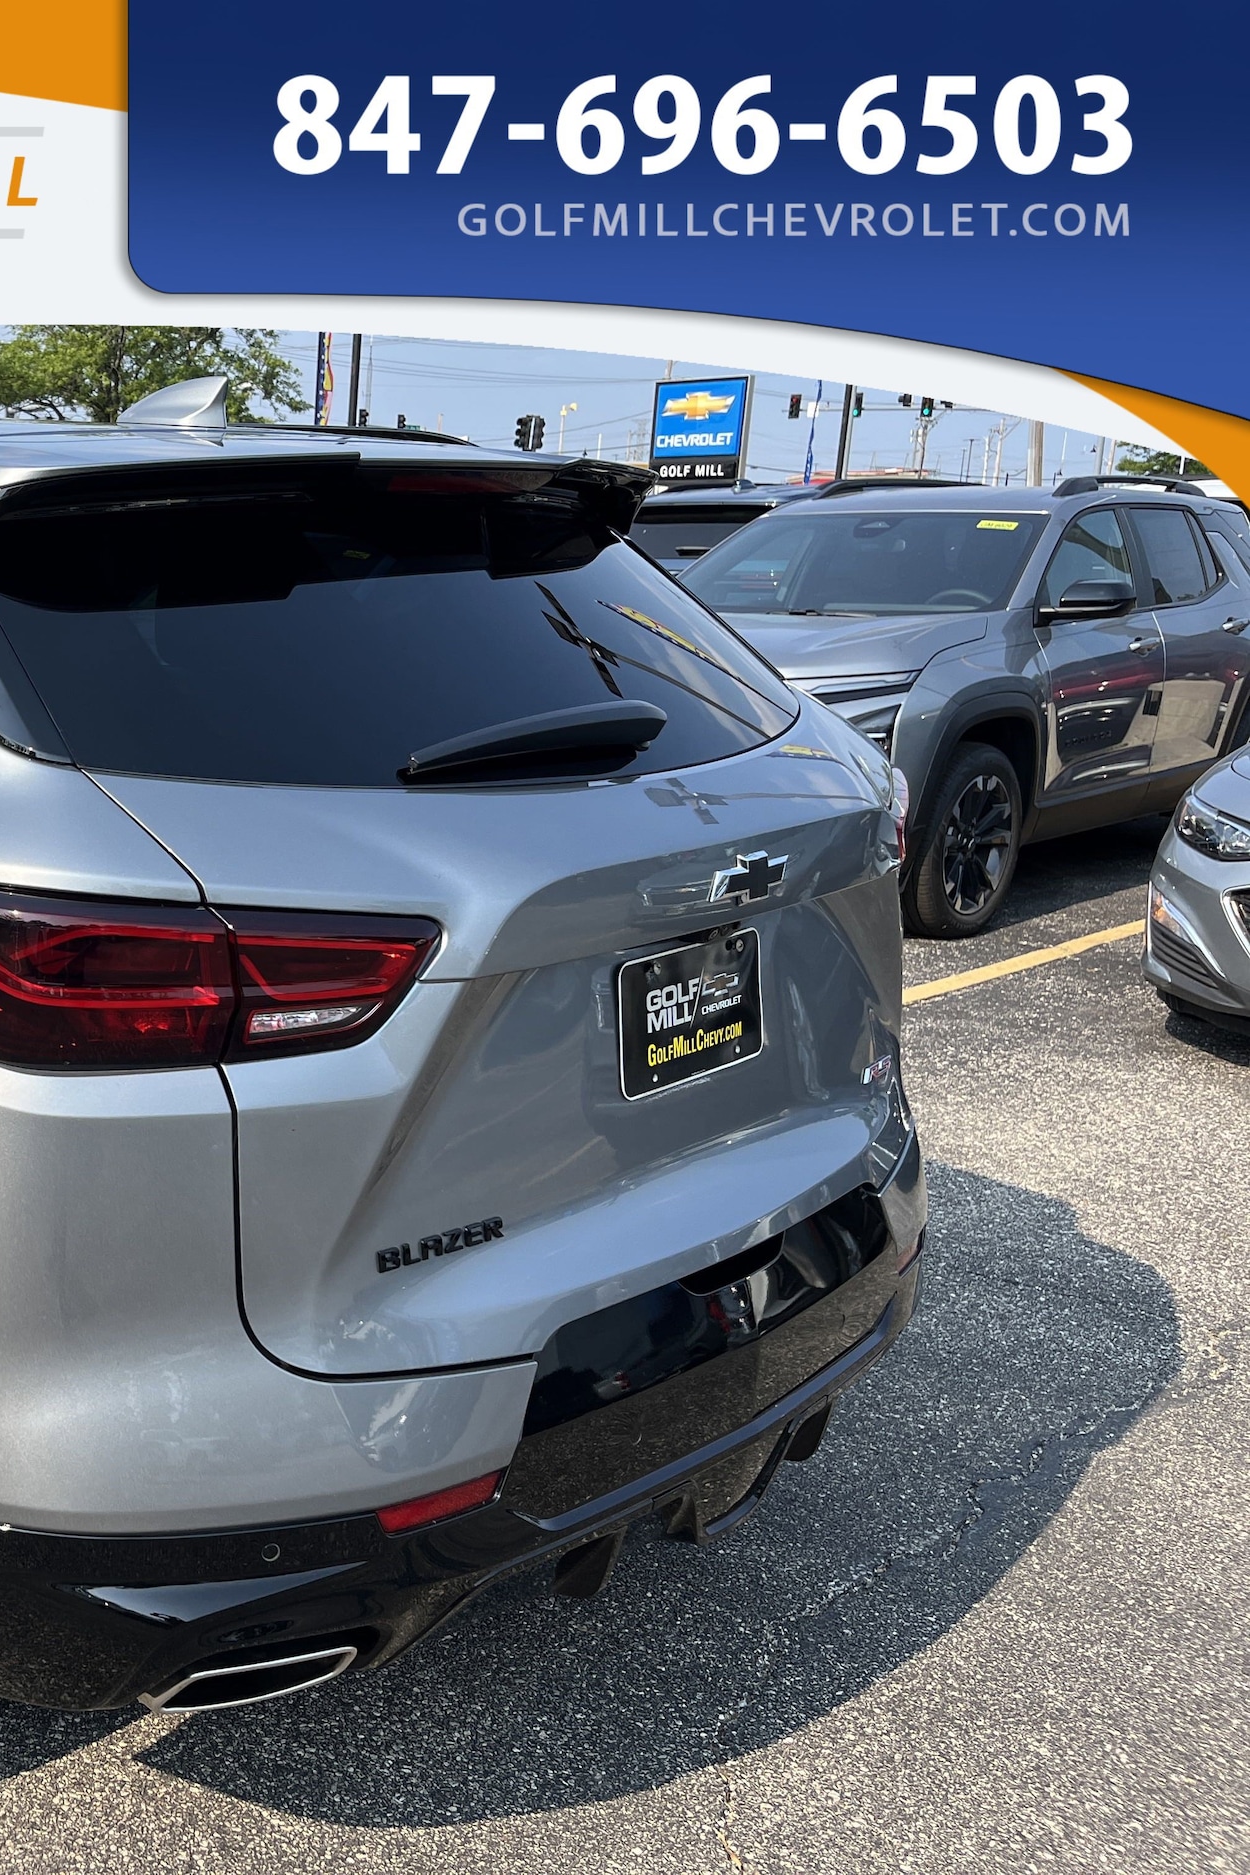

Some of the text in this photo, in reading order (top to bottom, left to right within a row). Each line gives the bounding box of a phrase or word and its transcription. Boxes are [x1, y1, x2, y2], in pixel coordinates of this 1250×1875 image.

[656, 432, 734, 448] CHEVROLET
[659, 463, 725, 478] GOLF MILL
[646, 977, 700, 1012] GOLF
[701, 994, 742, 1015] CHEVROLET
[647, 1002, 693, 1034] MILL
[376, 1216, 505, 1274] BLAZER
